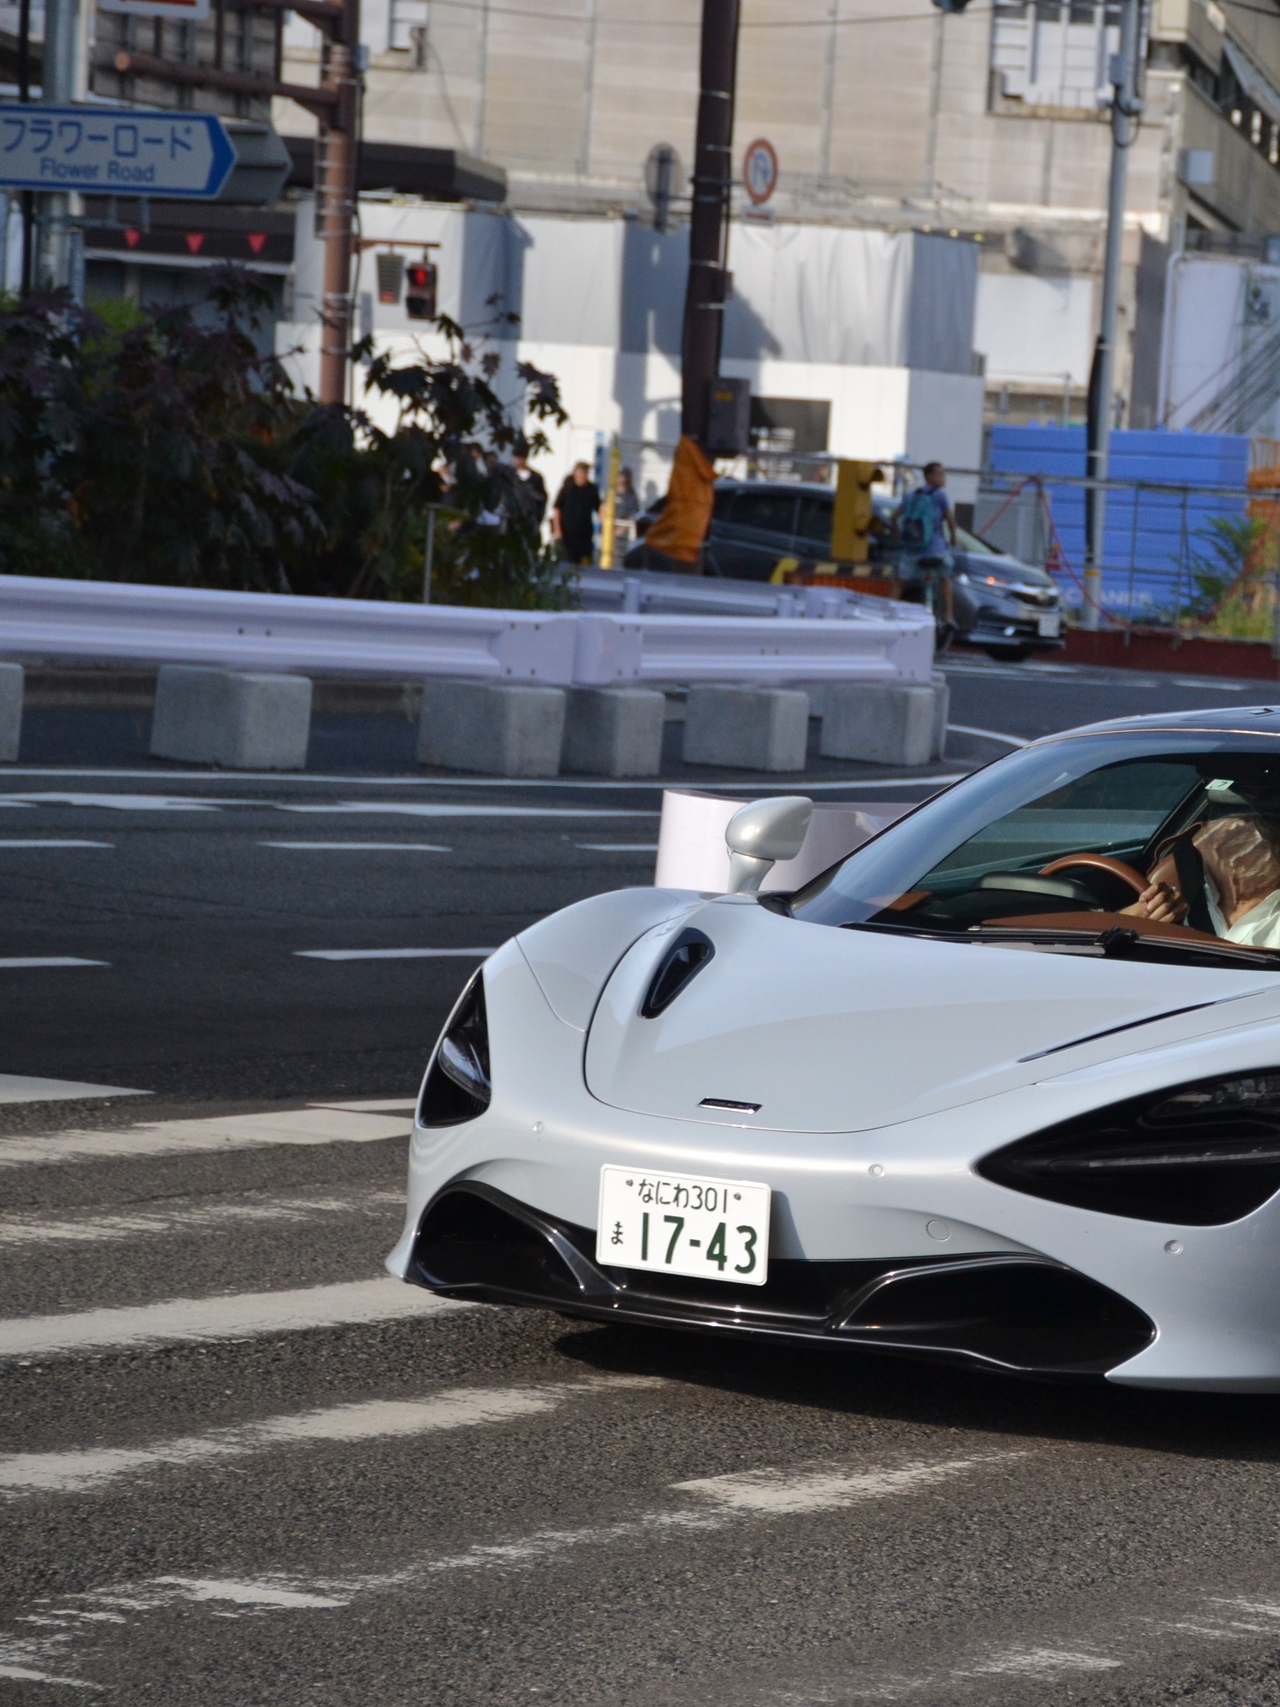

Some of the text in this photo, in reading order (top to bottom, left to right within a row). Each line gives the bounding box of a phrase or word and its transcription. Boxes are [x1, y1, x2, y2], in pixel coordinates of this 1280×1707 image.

[2, 117, 192, 160] フラワーロード
[40, 157, 155, 182] Flower Road
[610, 1211, 758, 1275] ま 17-43
